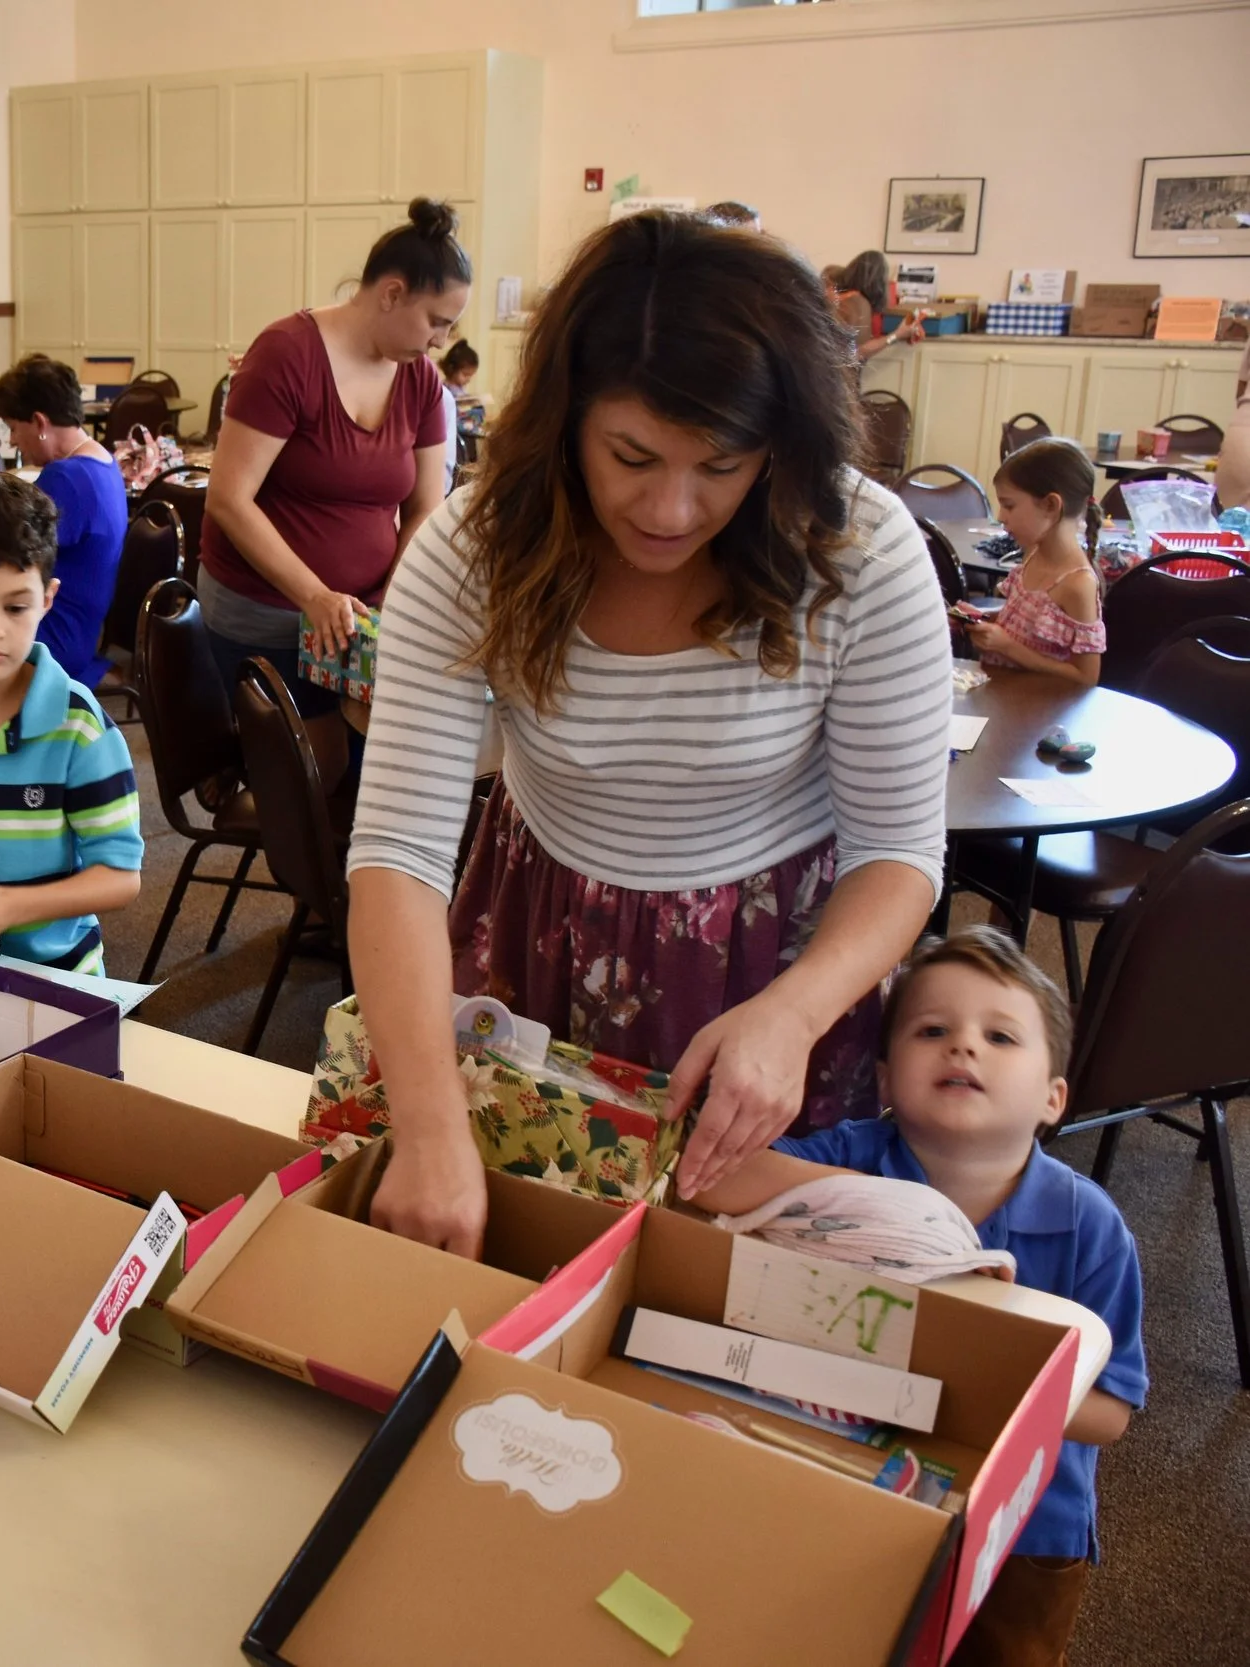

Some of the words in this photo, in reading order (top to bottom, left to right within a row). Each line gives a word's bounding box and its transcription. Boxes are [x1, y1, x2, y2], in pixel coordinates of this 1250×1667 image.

[104, 1260, 141, 1331] Relaxed
[69, 1337, 94, 1379] MEMORY
[50, 1379, 71, 1408] FOAM
[474, 1411, 609, 1474] GORGEOUS!
